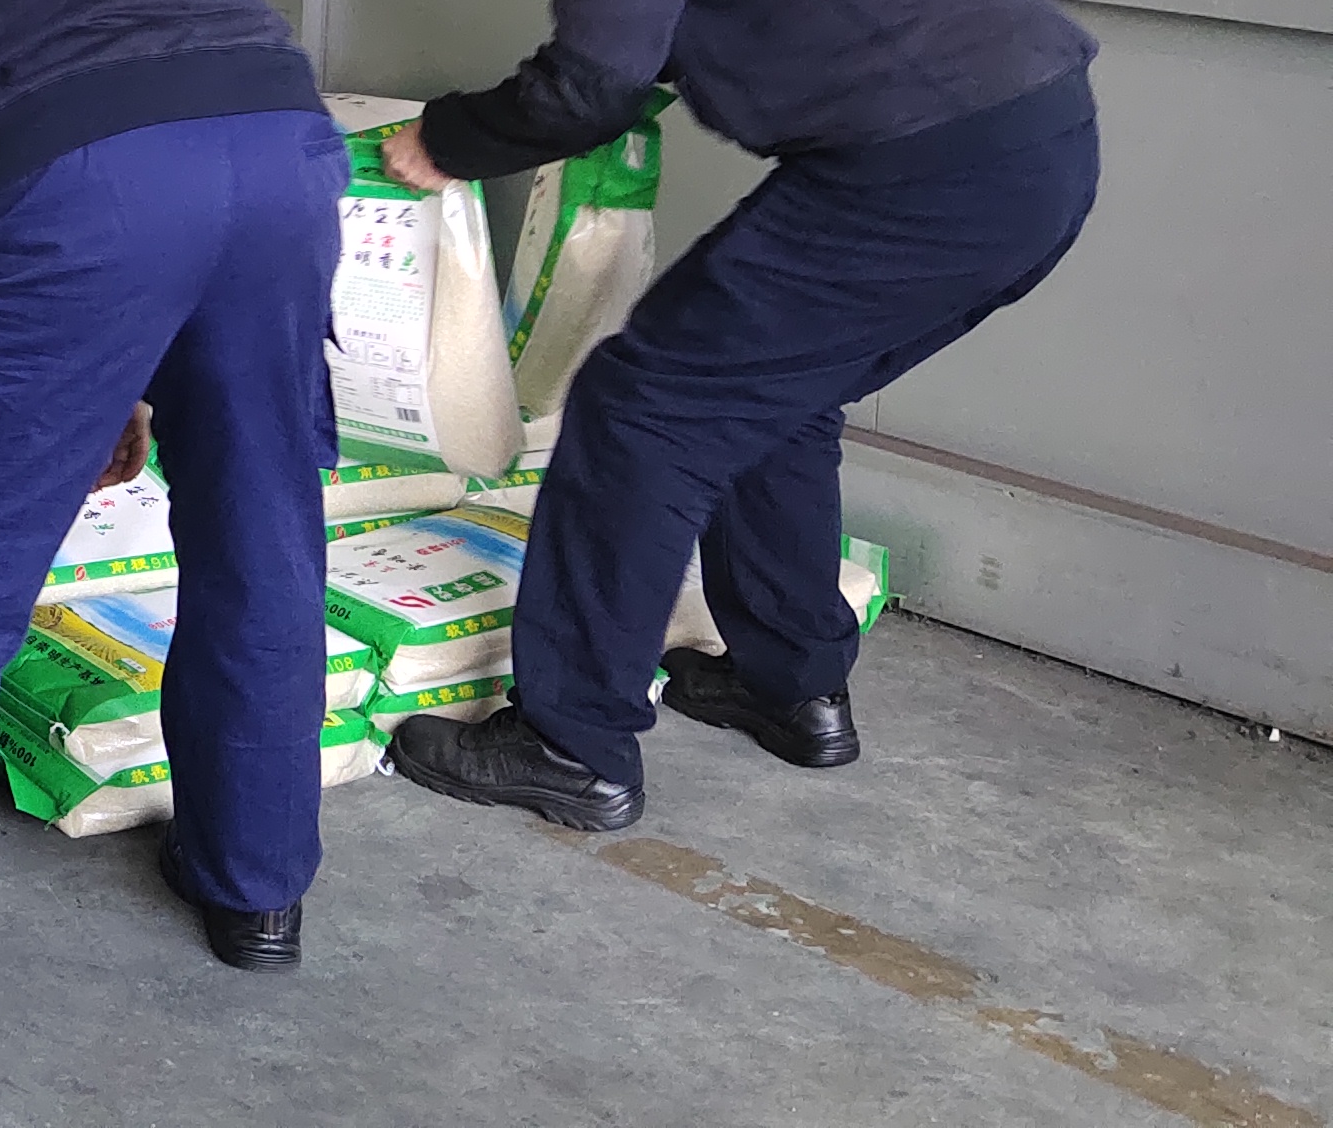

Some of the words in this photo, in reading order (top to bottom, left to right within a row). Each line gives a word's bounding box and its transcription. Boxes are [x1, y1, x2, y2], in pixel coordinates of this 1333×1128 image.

[339, 249, 420, 275] 明香米
[445, 615, 498, 639] 软香糯
[417, 684, 475, 706] 软香糯
